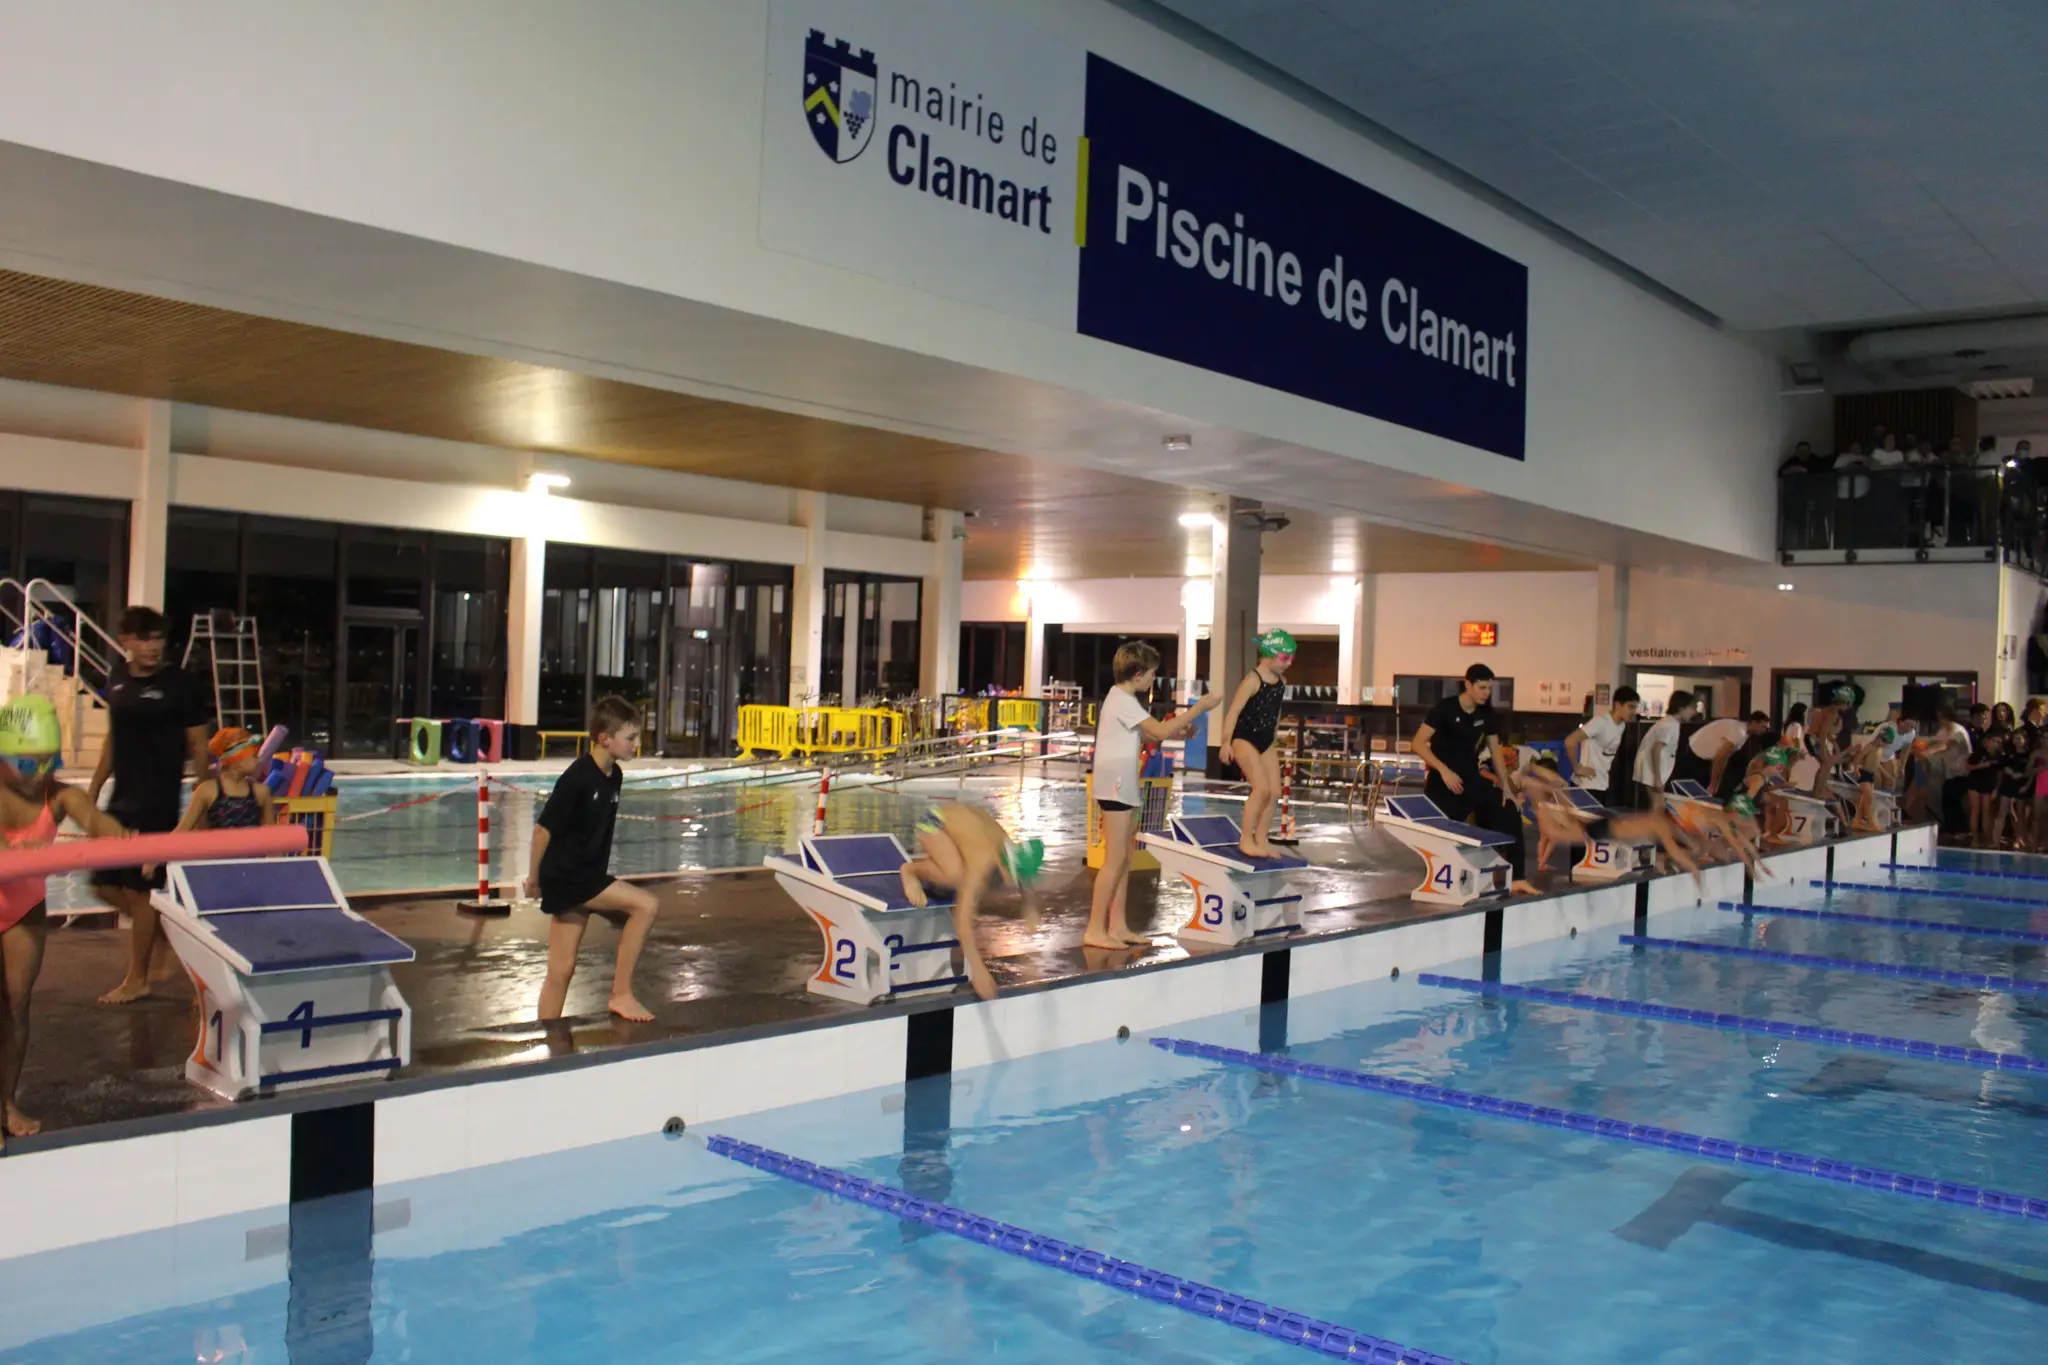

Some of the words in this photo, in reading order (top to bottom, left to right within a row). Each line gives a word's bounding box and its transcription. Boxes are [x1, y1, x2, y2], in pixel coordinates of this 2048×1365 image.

[890, 71, 1004, 144] mairie
[1020, 116, 1057, 165] de
[887, 124, 1052, 235] Clamart
[1115, 164, 1303, 306] Piscine
[1317, 254, 1368, 330] de
[1381, 277, 1516, 388] Clamart
[1629, 647, 1687, 658] vestiaires
[1794, 816, 1807, 833] 7
[1594, 842, 1609, 864] 5
[1434, 864, 1453, 889] 4
[1204, 894, 1223, 925] 3
[836, 938, 856, 979] 2
[210, 1010, 222, 1062] 1
